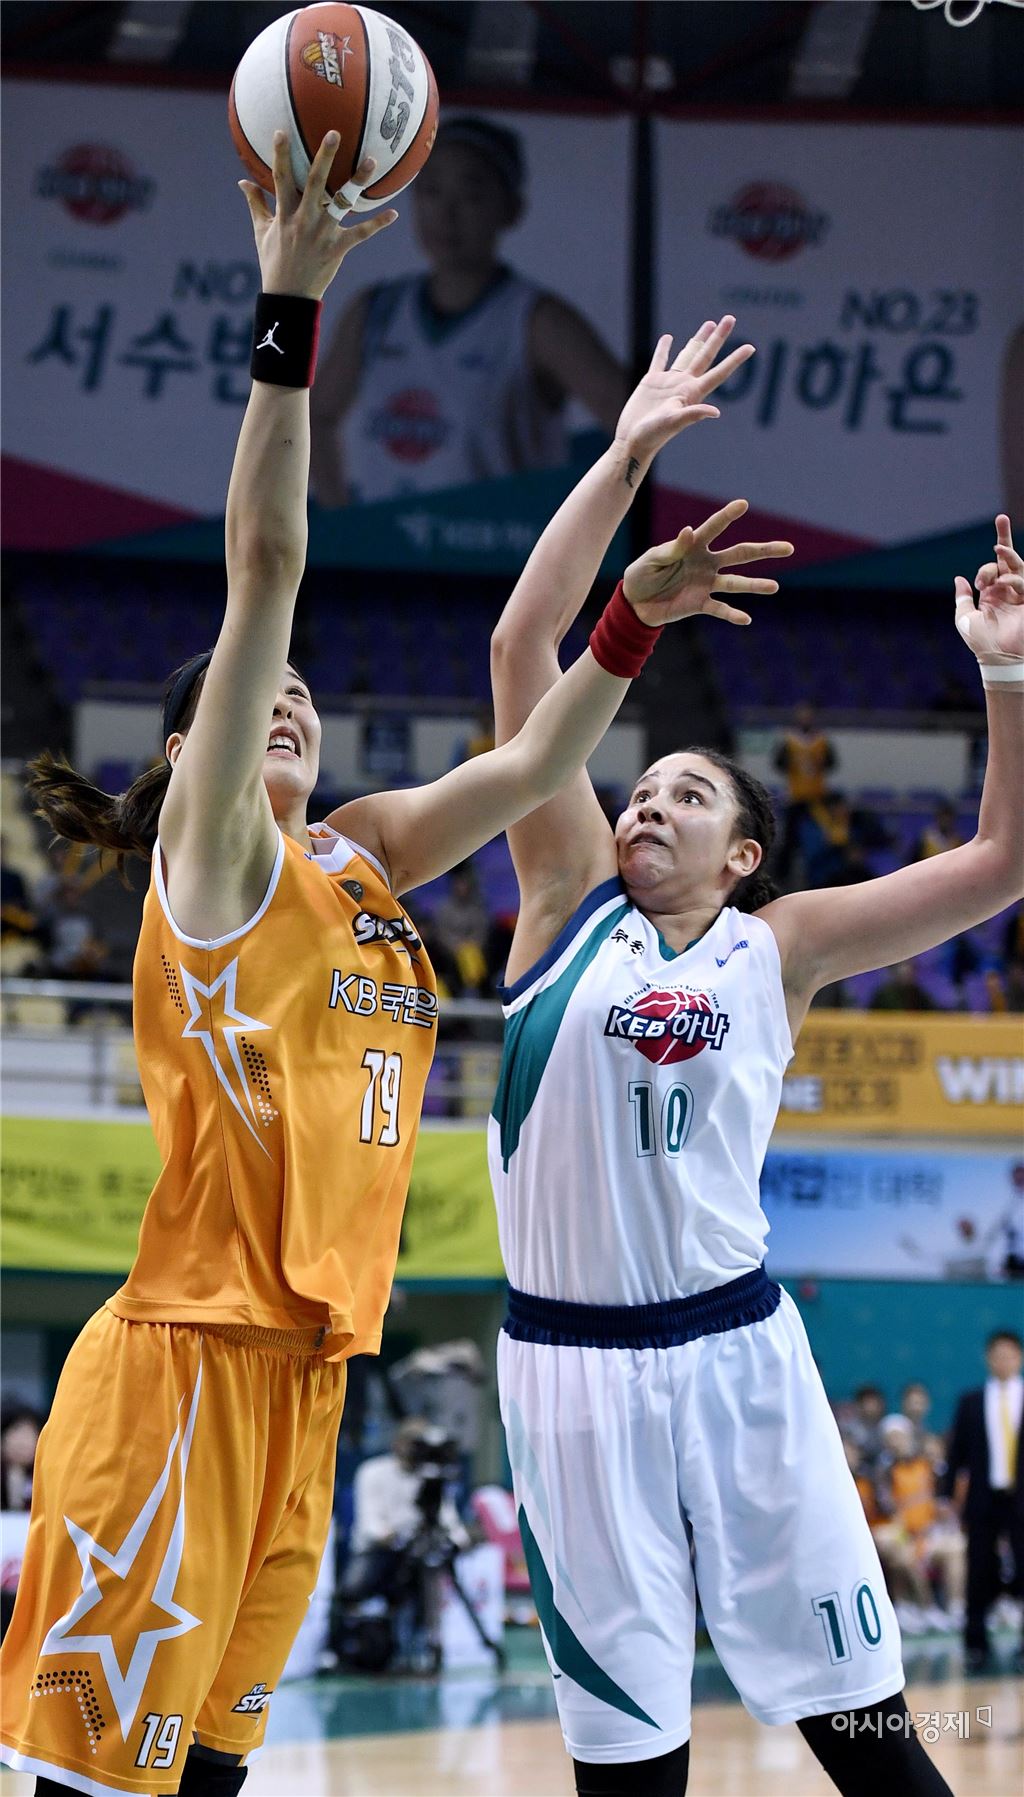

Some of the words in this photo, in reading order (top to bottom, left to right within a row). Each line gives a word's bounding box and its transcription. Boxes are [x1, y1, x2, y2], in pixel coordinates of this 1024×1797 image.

[172, 258, 258, 303] NO
[329, 969, 438, 1028] KB국민은
[605, 1006, 668, 1039] KEB
[670, 1009, 730, 1050] 하나
[628, 1080, 694, 1159] 10
[811, 1578, 884, 1665] 10
[231, 1691, 273, 1713] STA
[134, 1712, 183, 1769] 19
